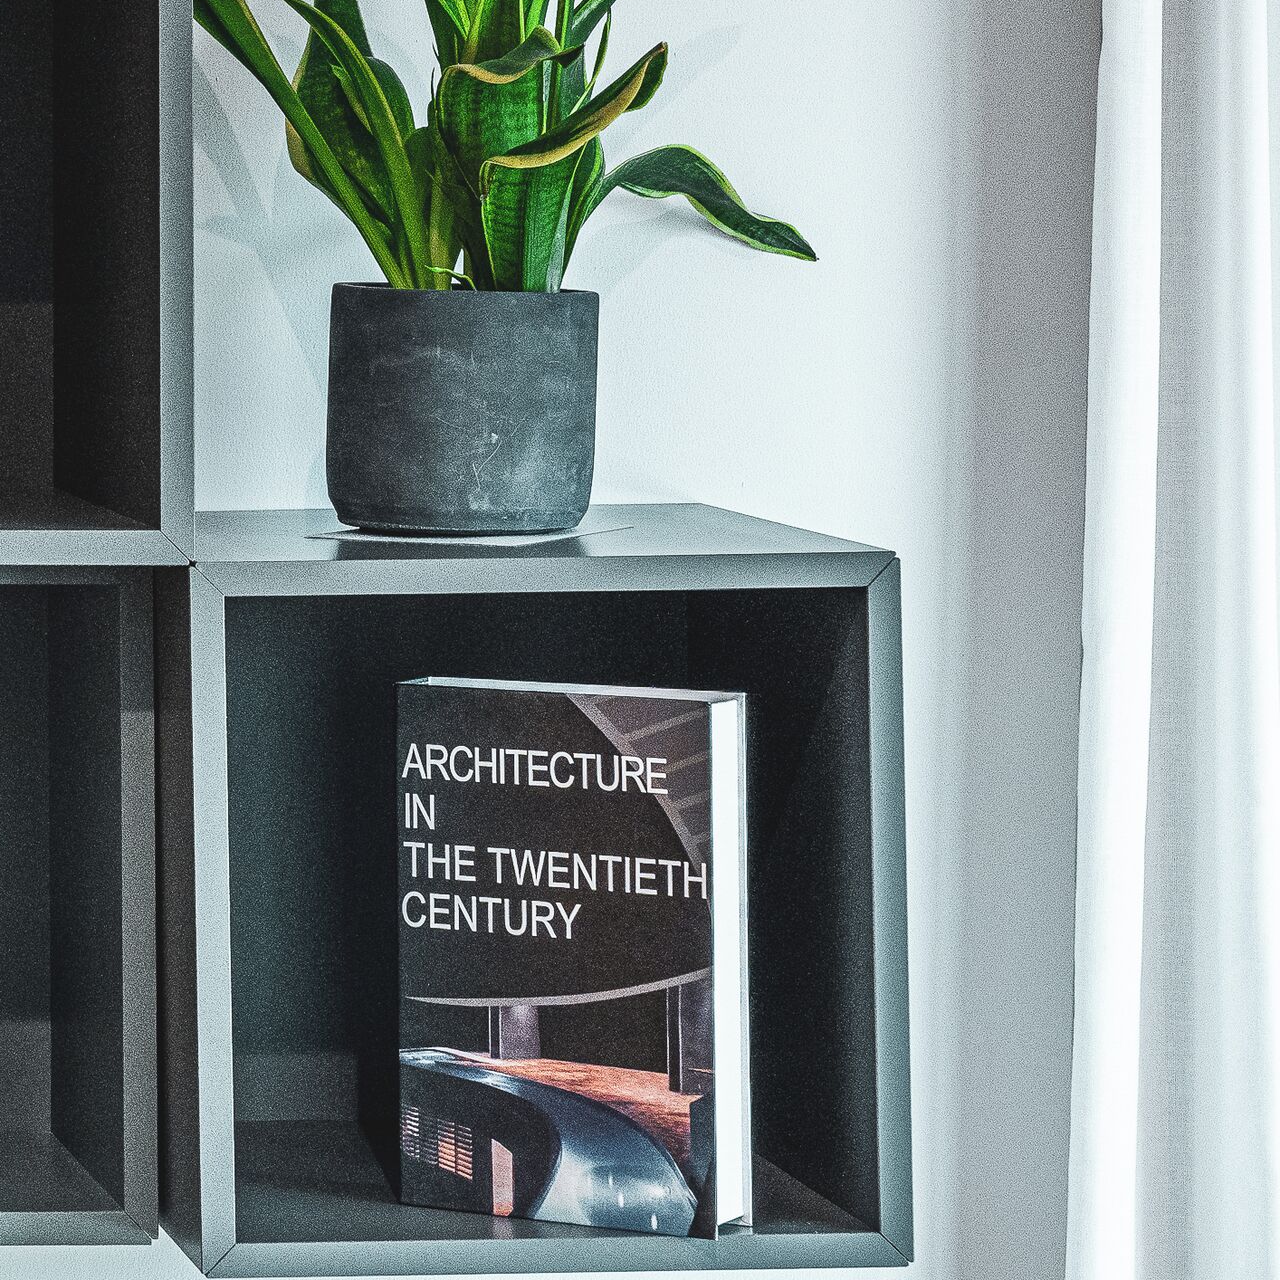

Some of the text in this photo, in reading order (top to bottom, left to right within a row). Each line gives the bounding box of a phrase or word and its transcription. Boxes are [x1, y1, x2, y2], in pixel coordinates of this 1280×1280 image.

[402, 742, 668, 795] ARCHITECTURE
[404, 793, 435, 830] IN
[403, 841, 708, 900] THE TWENTIETH
[402, 890, 582, 940] CENTURY
